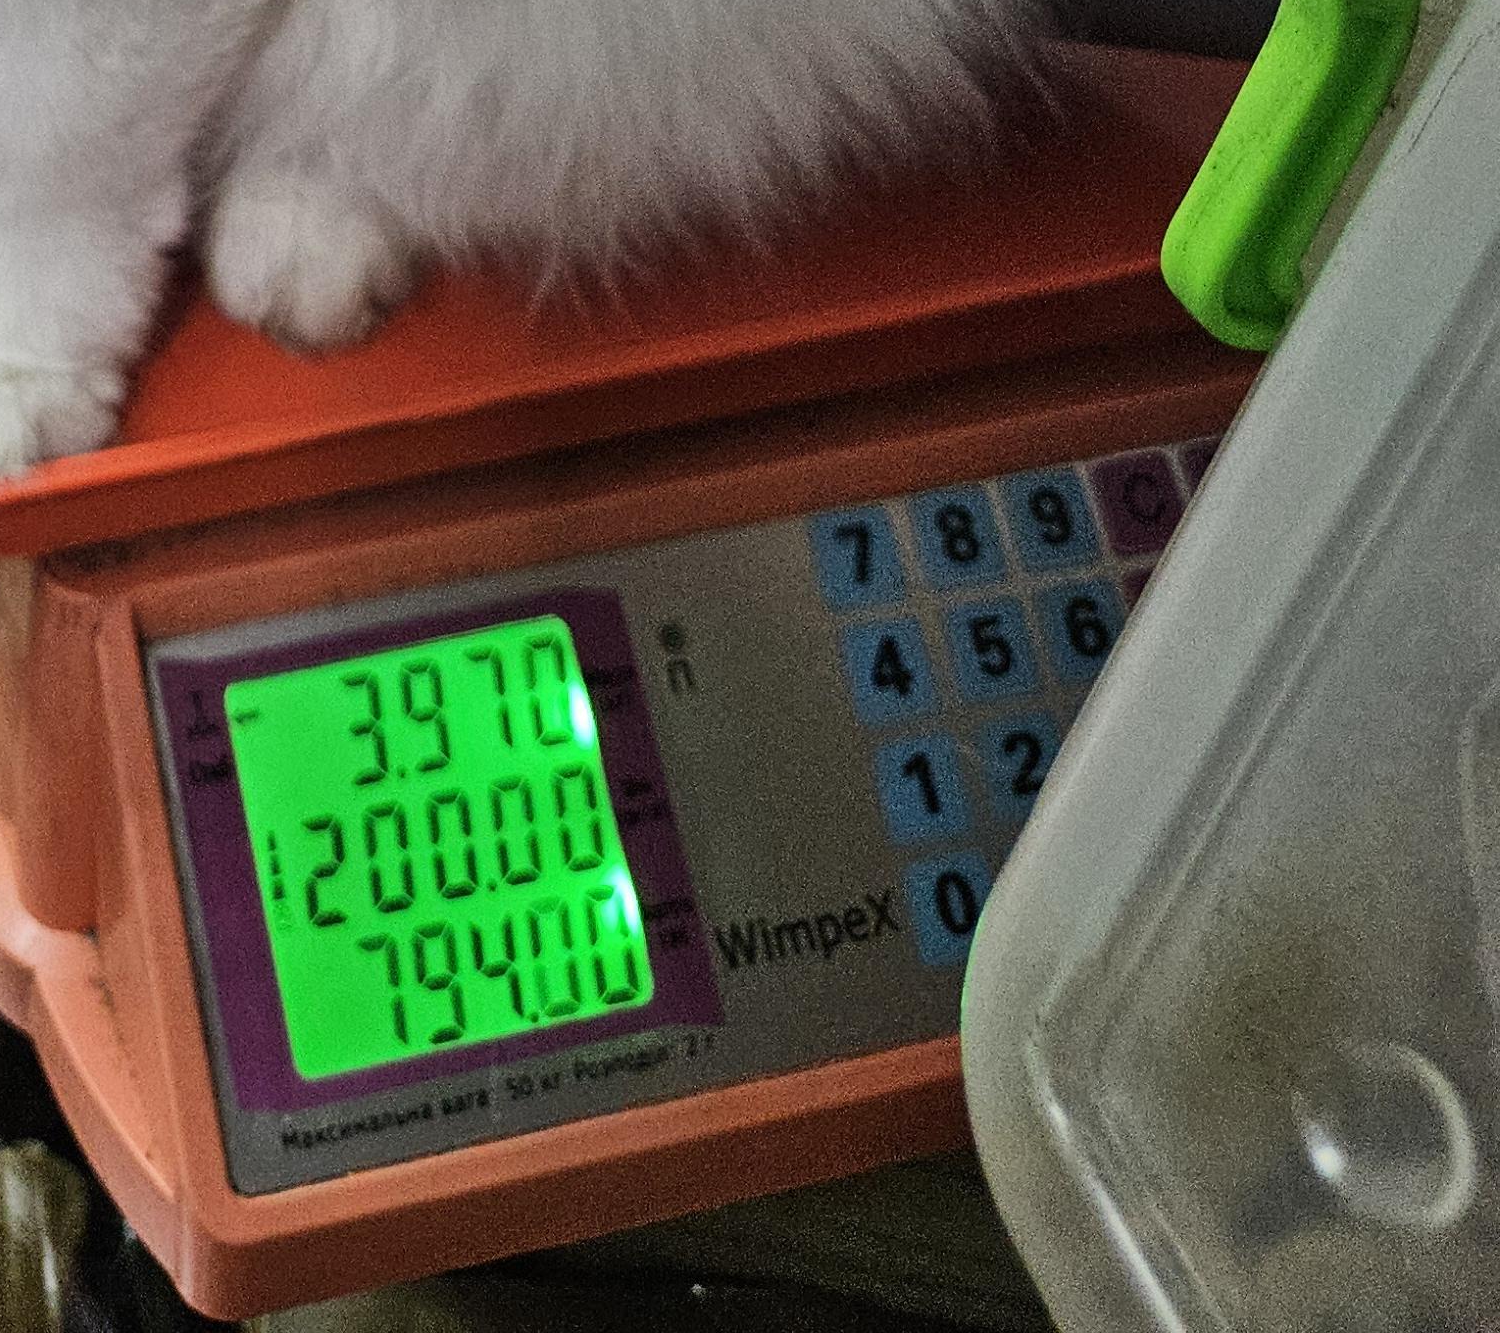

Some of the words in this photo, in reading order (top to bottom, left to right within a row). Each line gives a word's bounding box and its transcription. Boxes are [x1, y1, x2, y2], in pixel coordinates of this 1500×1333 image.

[835, 525, 873, 587] 7
[934, 503, 981, 565] 8
[1028, 485, 1072, 545] 9
[871, 635, 912, 699] 4
[970, 614, 1013, 678] 5
[1065, 595, 1112, 659] 6
[342, 633, 573, 787] 3.970
[906, 755, 940, 816] 1
[1002, 731, 1043, 797] 2
[712, 888, 902, 973] Wimpex
[935, 869, 979, 935] 0
[357, 883, 644, 1047] 794.00
